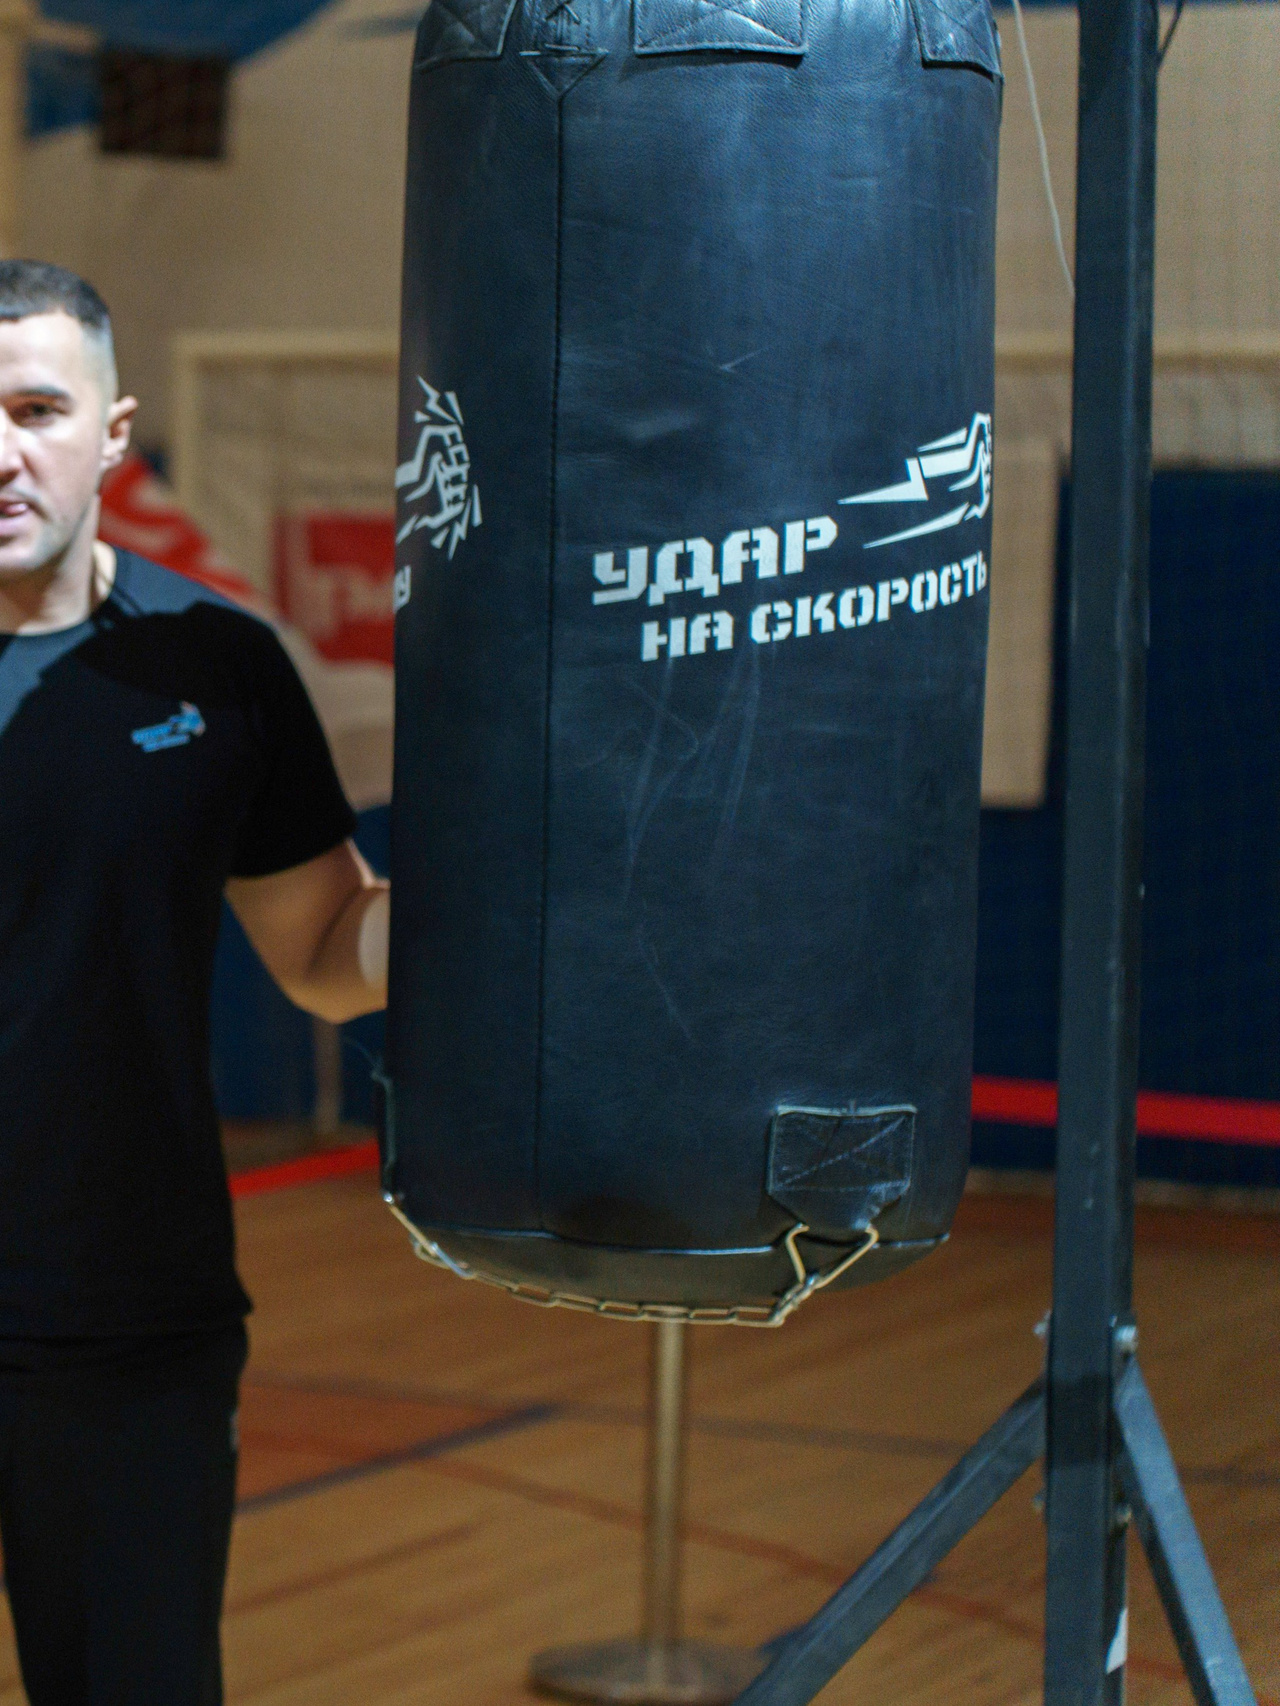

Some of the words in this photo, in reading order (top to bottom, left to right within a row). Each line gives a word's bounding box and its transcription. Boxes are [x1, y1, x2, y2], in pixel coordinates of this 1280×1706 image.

[592, 515, 838, 606] УДАР
[641, 610, 734, 662] НА
[750, 550, 987, 645] СКОРОСТЬ
